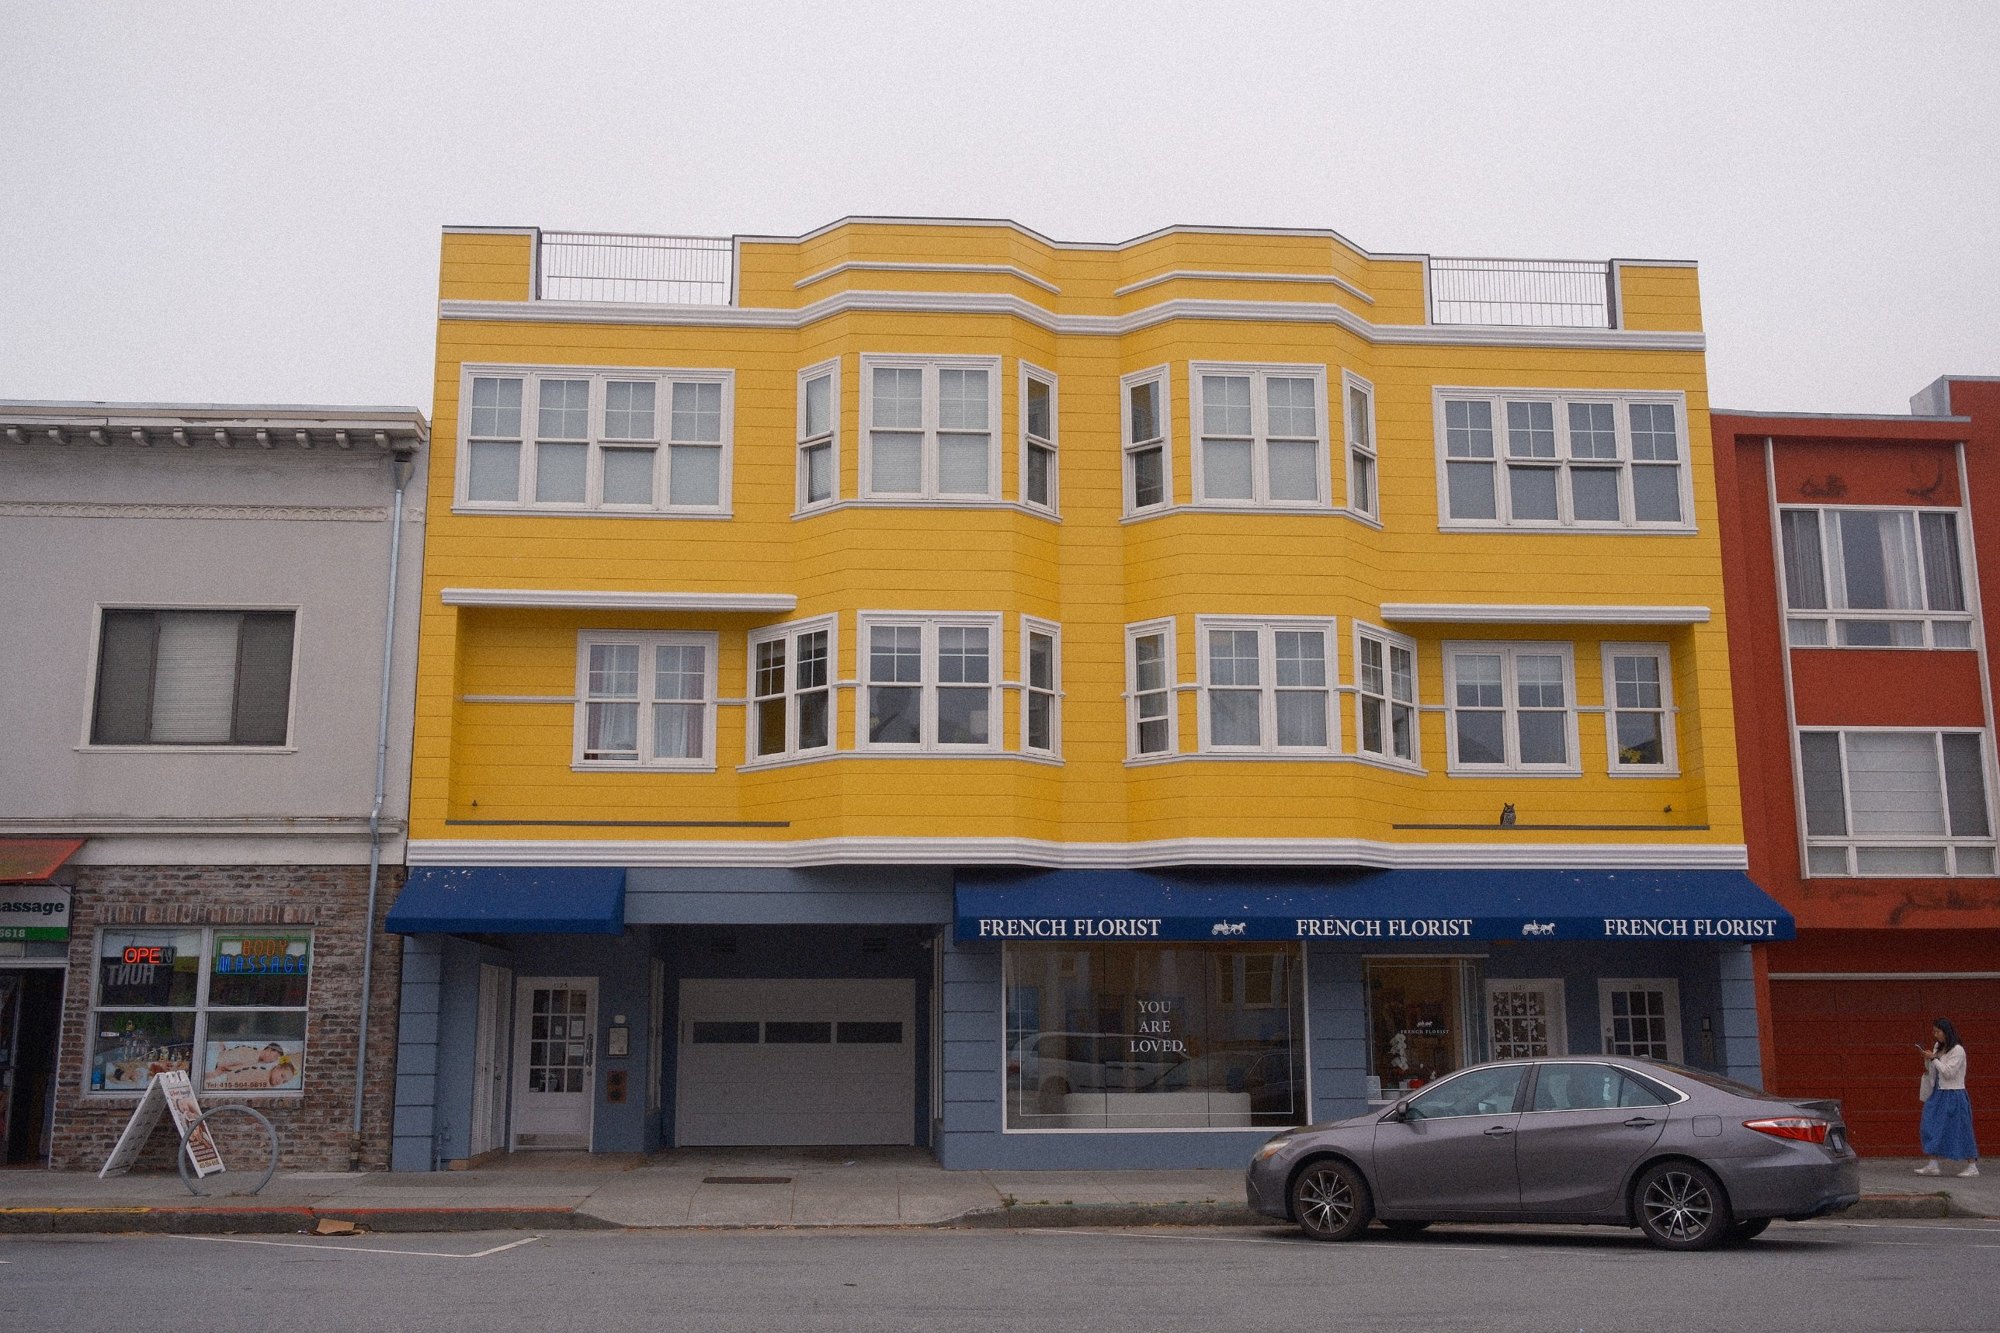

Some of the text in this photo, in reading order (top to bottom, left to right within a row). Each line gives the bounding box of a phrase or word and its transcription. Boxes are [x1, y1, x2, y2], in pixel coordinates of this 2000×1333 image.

[0, 902, 65, 915] assage
[979, 918, 1162, 936] FRENCH FLORIST
[1296, 919, 1473, 936] FRENCH FLORIST
[1603, 918, 1777, 936] FRENCH FLORIST
[124, 946, 174, 964] OPEN
[242, 939, 289, 956] BODY
[218, 955, 306, 973] MASSAGE
[1138, 1000, 1171, 1013] YOU
[1139, 1020, 1171, 1033] ARE
[1130, 1039, 1187, 1053] LOVED.
